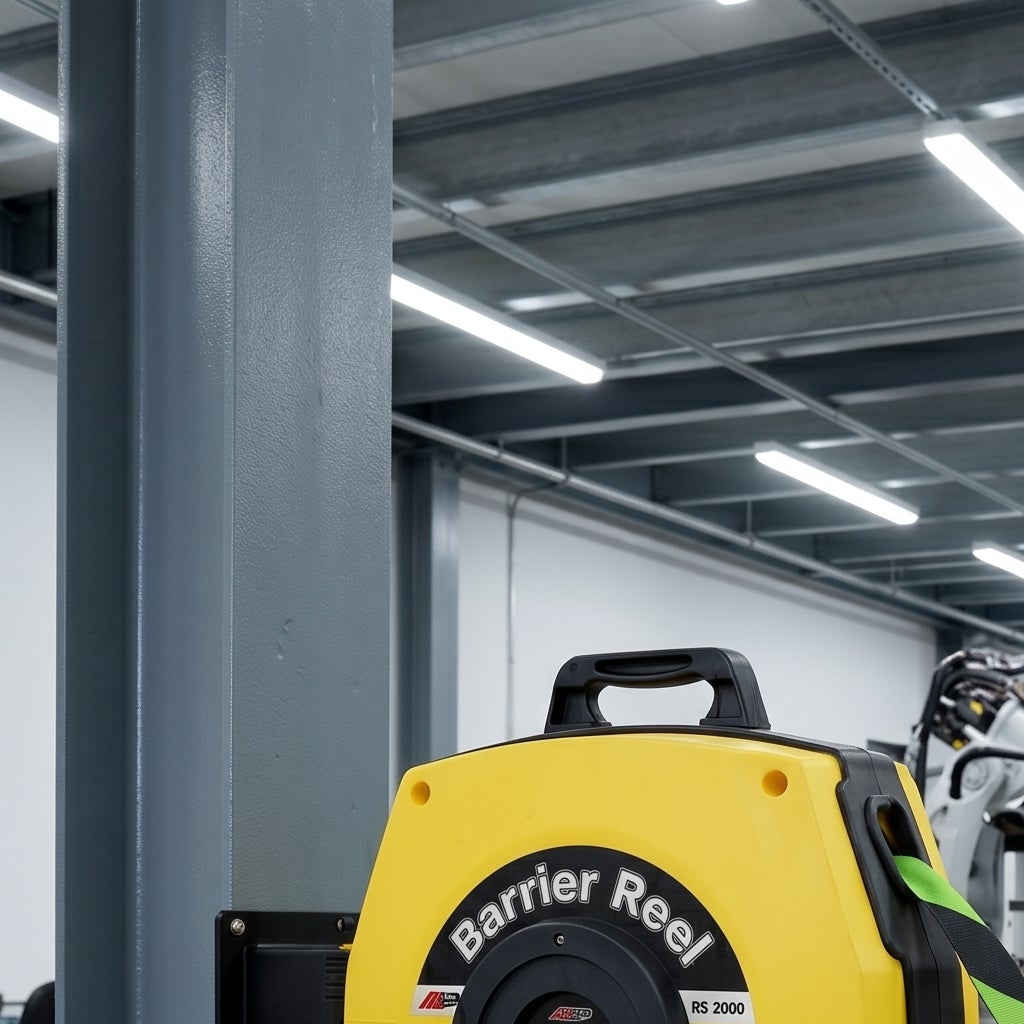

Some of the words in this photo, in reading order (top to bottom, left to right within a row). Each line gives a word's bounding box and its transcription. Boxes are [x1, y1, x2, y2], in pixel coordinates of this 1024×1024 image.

[448, 861, 600, 965] Barrier
[609, 866, 715, 969] Reel
[691, 1001, 709, 1014] RS
[712, 1001, 745, 1015] 2000
